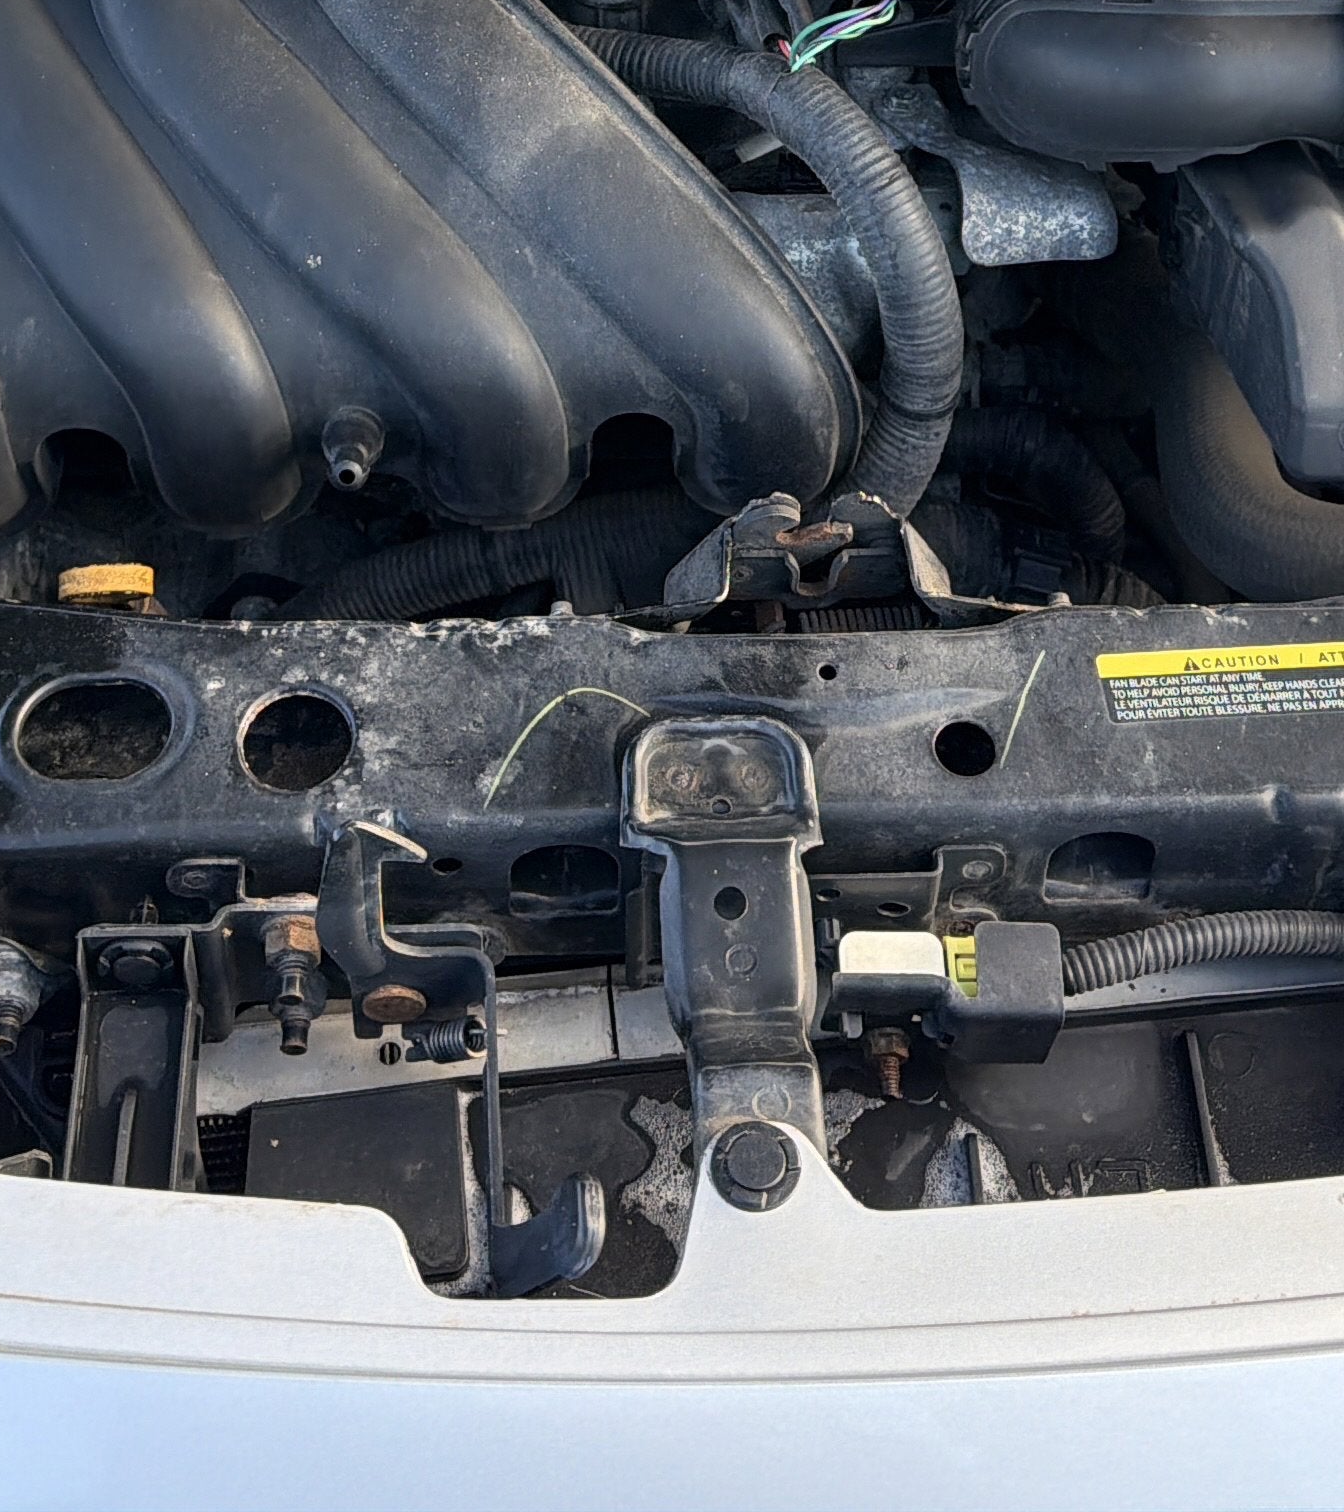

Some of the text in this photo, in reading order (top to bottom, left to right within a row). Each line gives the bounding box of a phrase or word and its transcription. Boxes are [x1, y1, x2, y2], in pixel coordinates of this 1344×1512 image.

[1202, 654, 1279, 668] CAUTION
[1110, 680, 1128, 688] FAN
[1129, 678, 1158, 687] BLADE
[1159, 677, 1180, 686] CAN
[1180, 675, 1206, 684] START
[1209, 674, 1220, 683] AT
[1222, 673, 1240, 682] ANY
[1112, 690, 1126, 699] TO
[1129, 688, 1150, 698] HELP
[1152, 686, 1180, 696] AVOID
[1181, 684, 1226, 694] PERSONAL
[1263, 681, 1284, 690] KEEP
[1285, 680, 1317, 689] HANDS
[1115, 700, 1127, 709] LE
[1129, 696, 1194, 708] VENTILATEUR
[1196, 694, 1230, 705] RISQUE
[1233, 694, 1246, 703] DE
[1313, 689, 1338, 698] TOUT
[1117, 711, 1145, 720] POUR
[1147, 707, 1181, 718] ÉVITER
[1182, 706, 1214, 717] TOUTE
[1267, 703, 1281, 712] NE
[1288, 701, 1302, 711] PAS
[1303, 701, 1317, 710] EN
